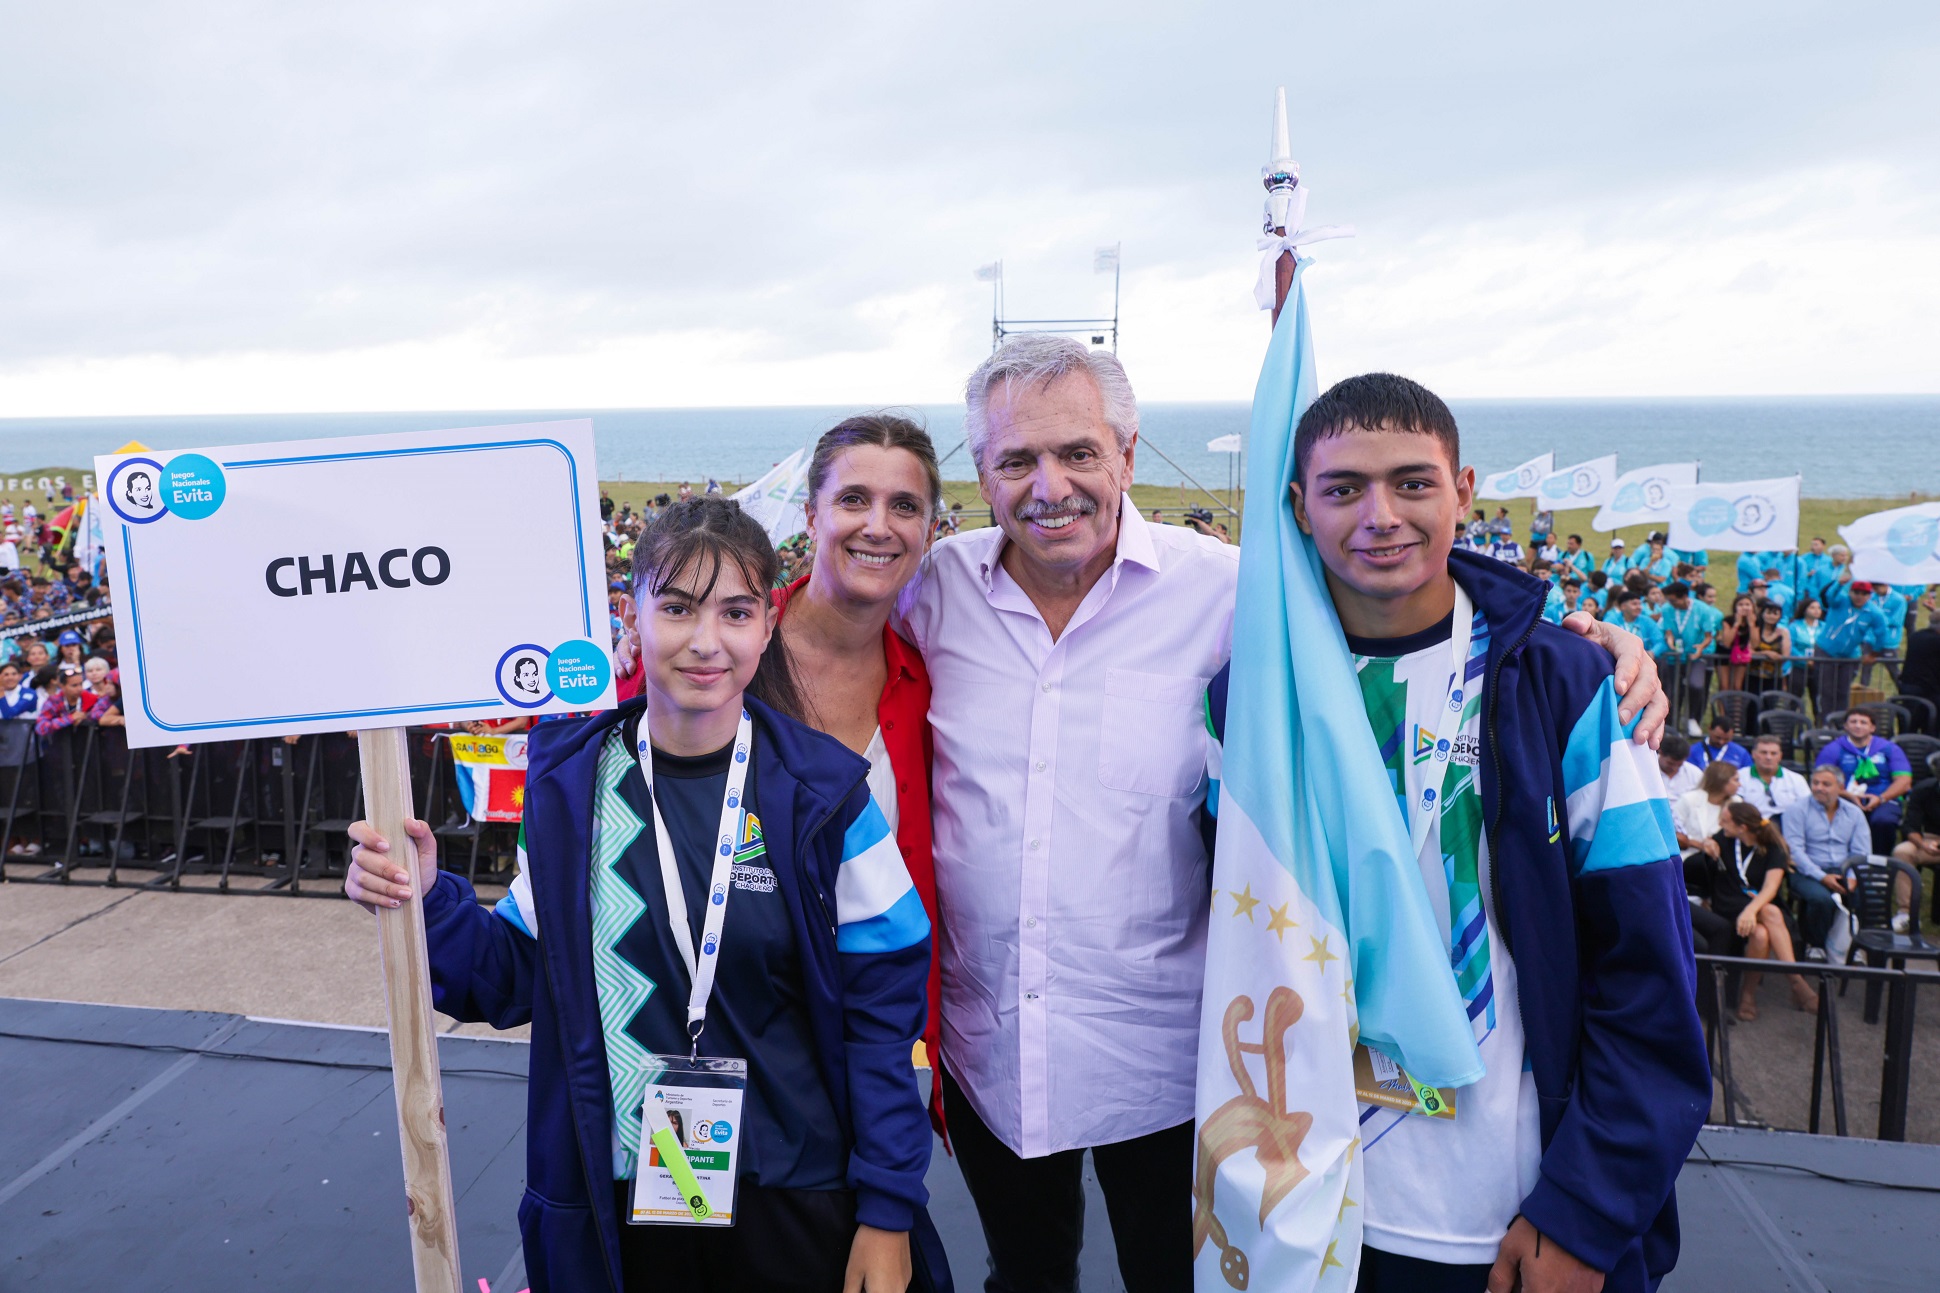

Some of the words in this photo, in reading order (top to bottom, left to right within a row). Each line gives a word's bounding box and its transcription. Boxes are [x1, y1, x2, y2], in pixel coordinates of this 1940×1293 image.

[171, 472, 195, 480] Juegos
[172, 478, 210, 487] Nacionales
[173, 488, 213, 504] Evita
[265, 545, 451, 598] CHACO
[557, 657, 581, 666] Juegos
[558, 664, 596, 673] Nacionales
[559, 673, 598, 689] Evita
[730, 872, 778, 887] DEPORTE
